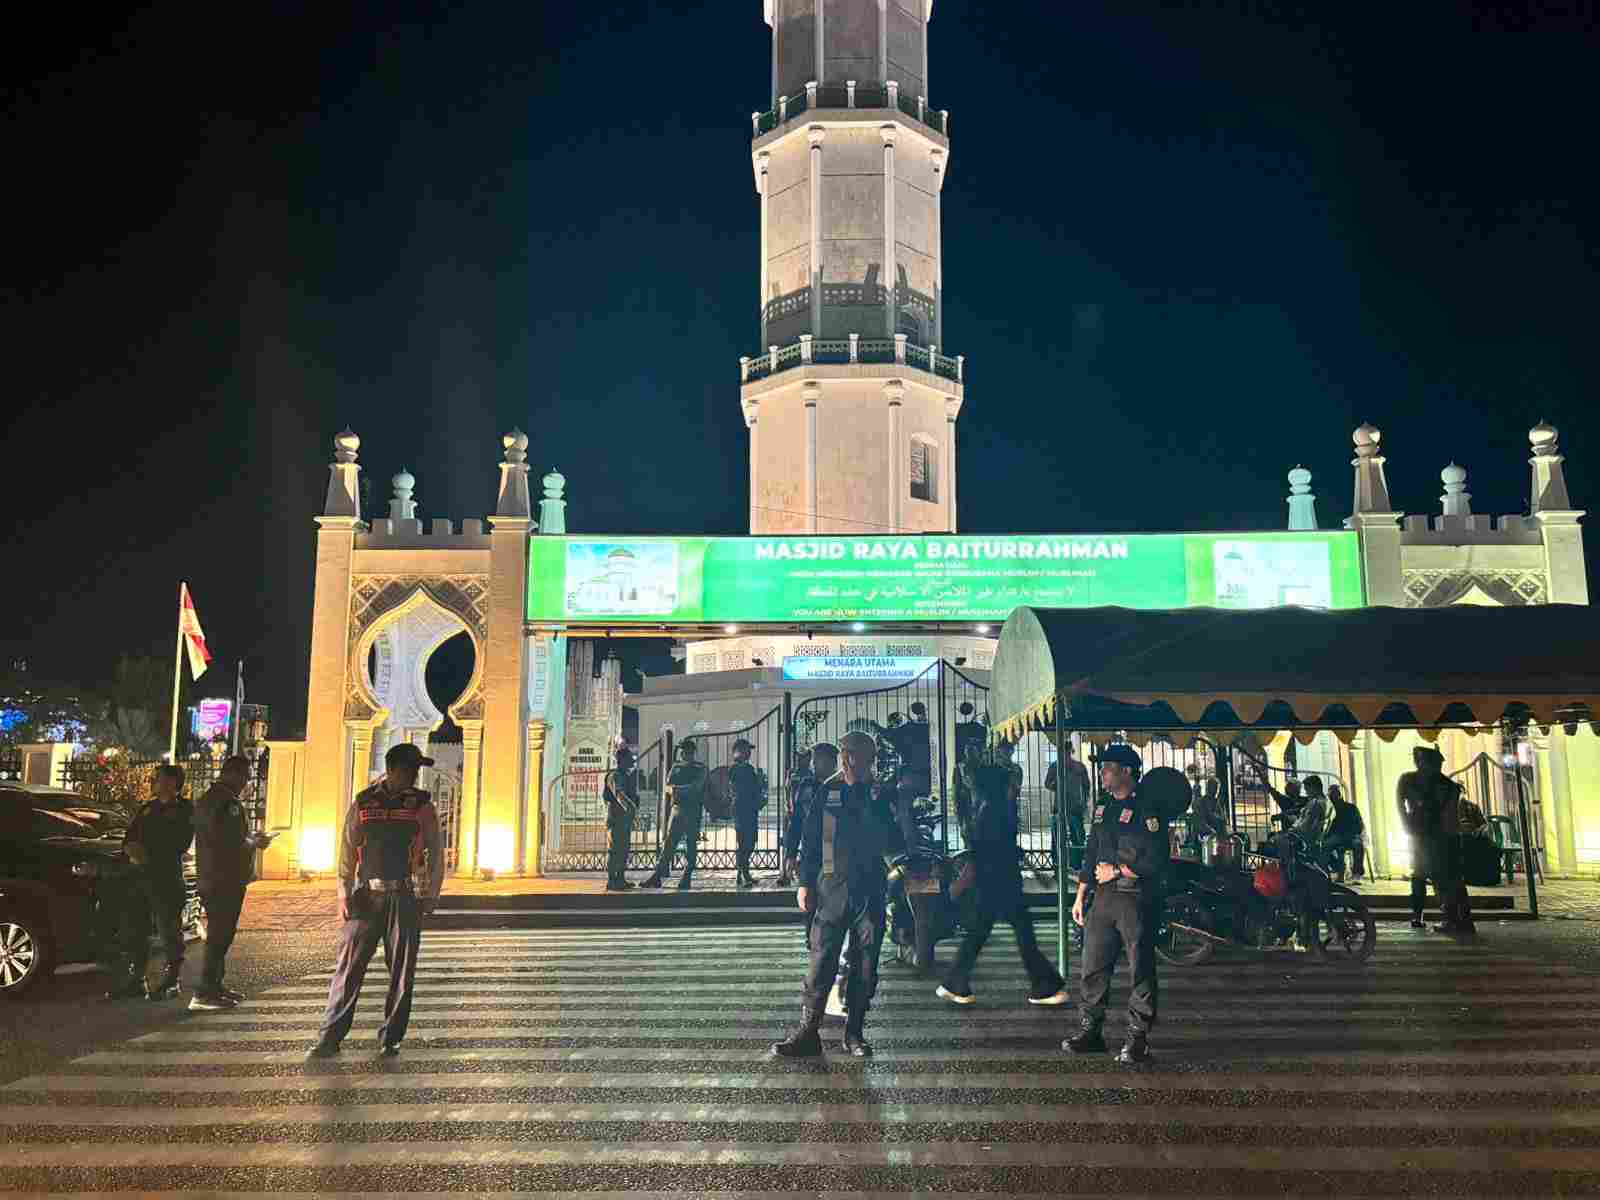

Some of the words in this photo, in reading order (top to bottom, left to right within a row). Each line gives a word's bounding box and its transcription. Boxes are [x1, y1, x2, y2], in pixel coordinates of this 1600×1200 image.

[755, 542, 845, 560] MASJID
[854, 542, 918, 560] RAYA
[927, 541, 1129, 559] BAITURRAHMAN
[825, 658, 862, 667] MENARA
[864, 658, 896, 667] UTAMA
